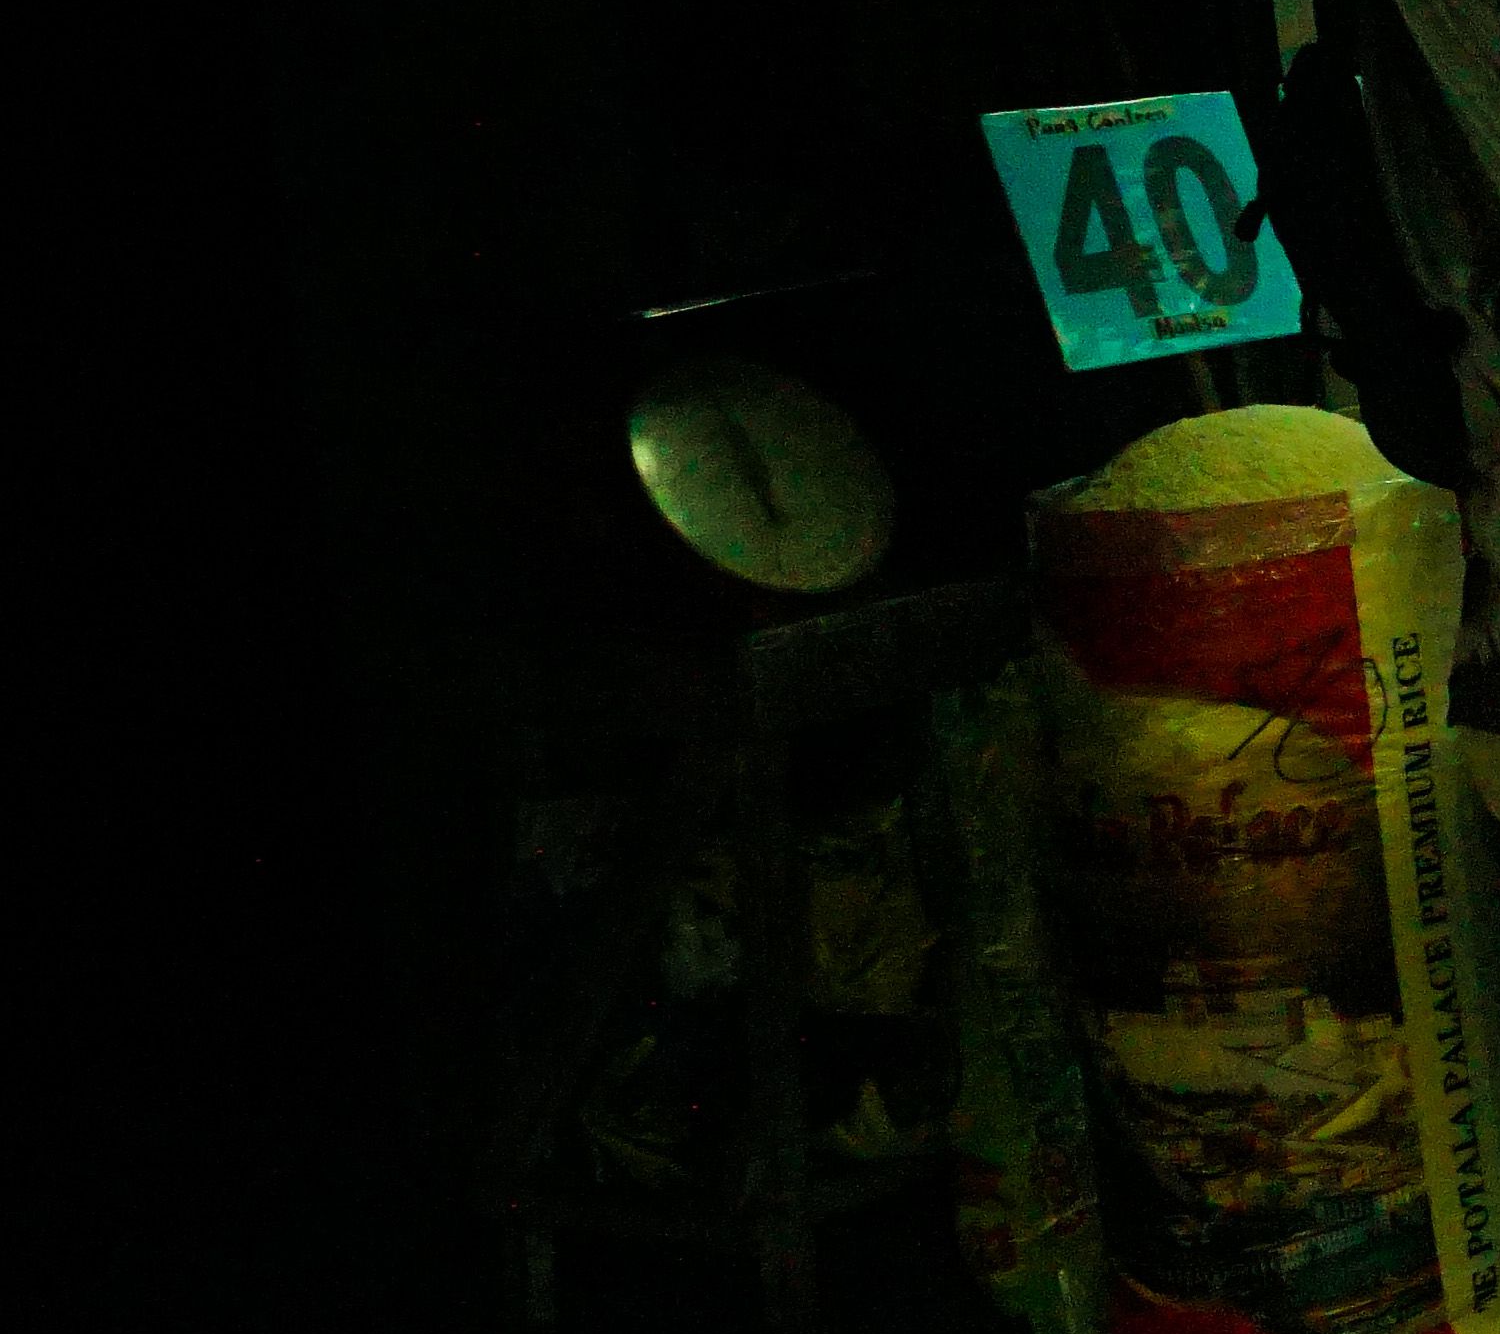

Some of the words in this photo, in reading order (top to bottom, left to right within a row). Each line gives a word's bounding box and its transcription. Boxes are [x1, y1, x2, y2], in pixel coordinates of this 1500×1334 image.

[1053, 135, 1259, 318] 40
[1392, 632, 1430, 730] RICE
[1405, 741, 1448, 928] PREMIUM
[1424, 937, 1471, 1095] PALACE
[1450, 1103, 1494, 1259] POTALA
